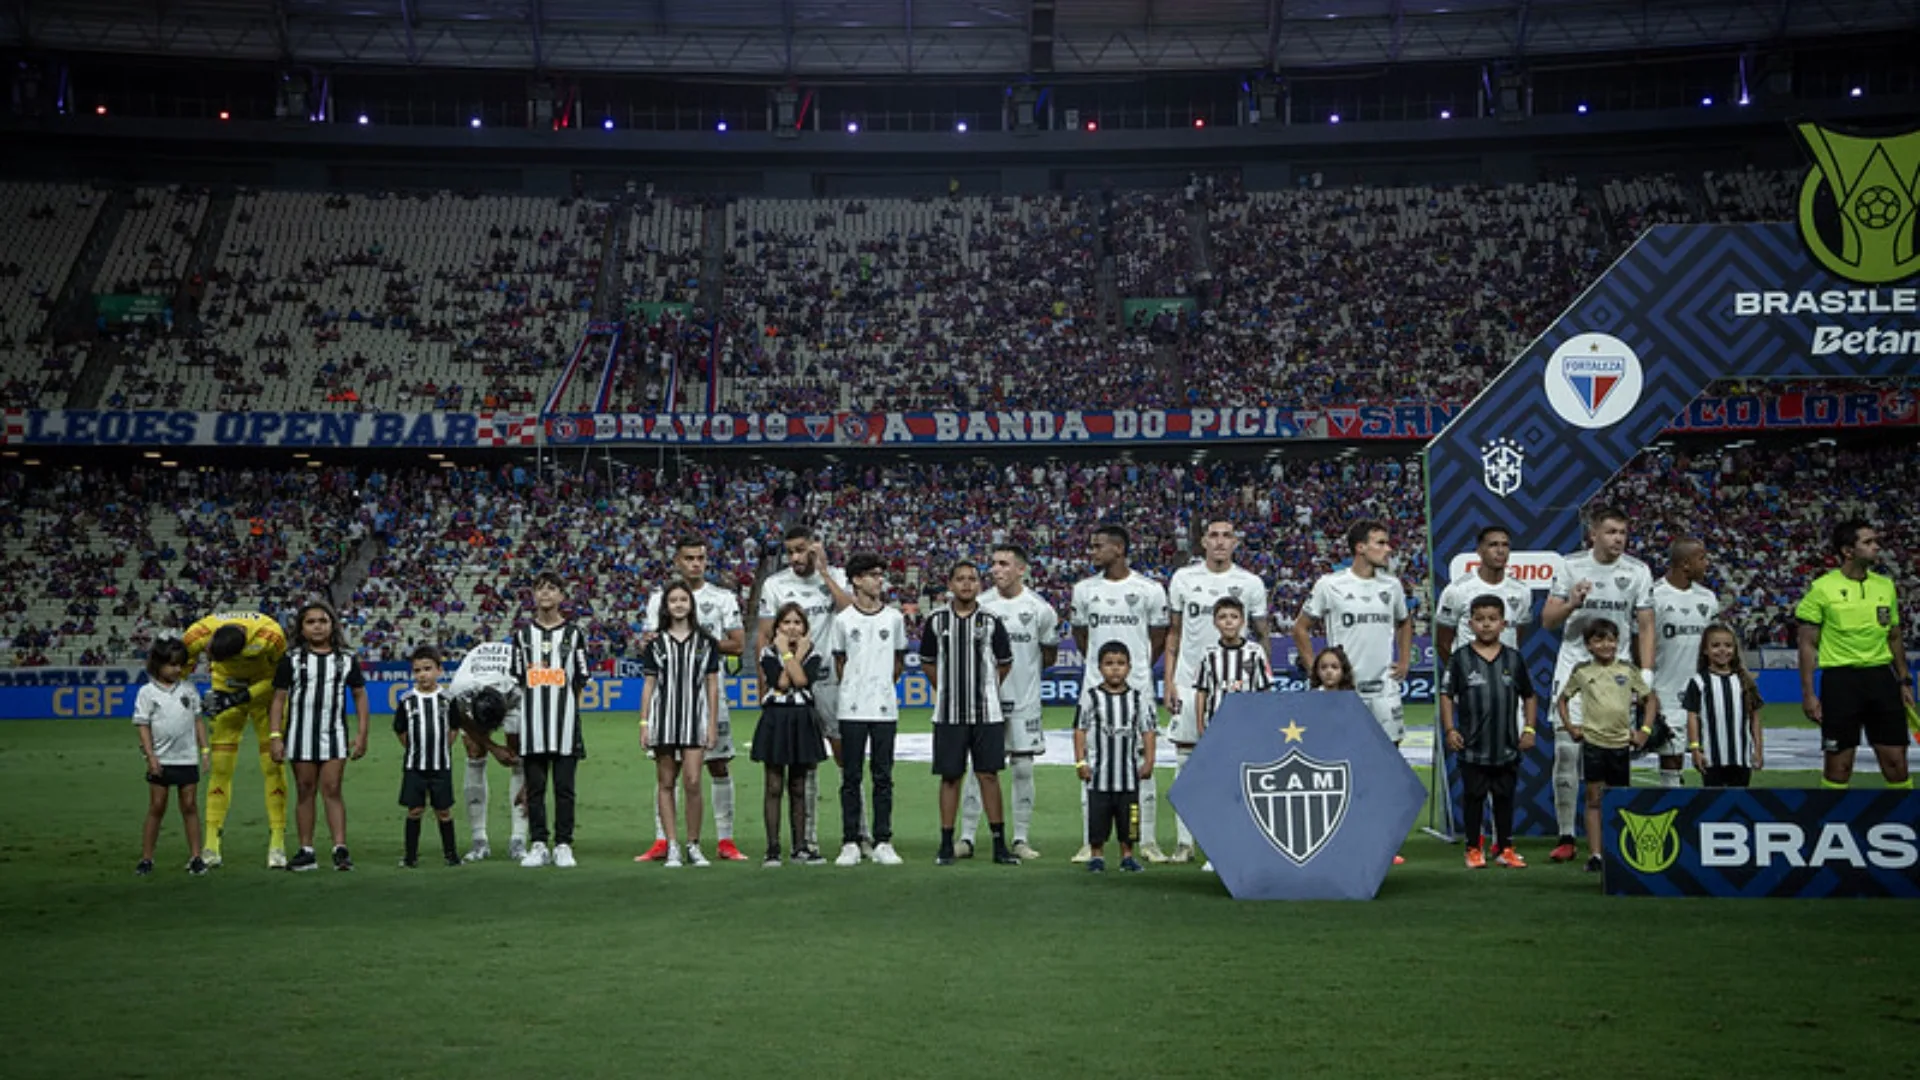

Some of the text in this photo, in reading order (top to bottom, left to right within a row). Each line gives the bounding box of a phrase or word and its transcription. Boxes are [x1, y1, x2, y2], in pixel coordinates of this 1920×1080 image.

[1735, 288, 1917, 315] BRASILE
[1564, 360, 1621, 371] FORTALEZA
[25, 410, 479, 446] LEOES OPEN BAR
[594, 413, 734, 443] BRAVO
[882, 406, 1280, 442] A BANDA DO PICI
[52, 686, 125, 716] CBF
[579, 680, 623, 709] BF
[724, 679, 759, 706] CB
[1259, 771, 1335, 790] CAM
[1700, 822, 1919, 869] BRAS
